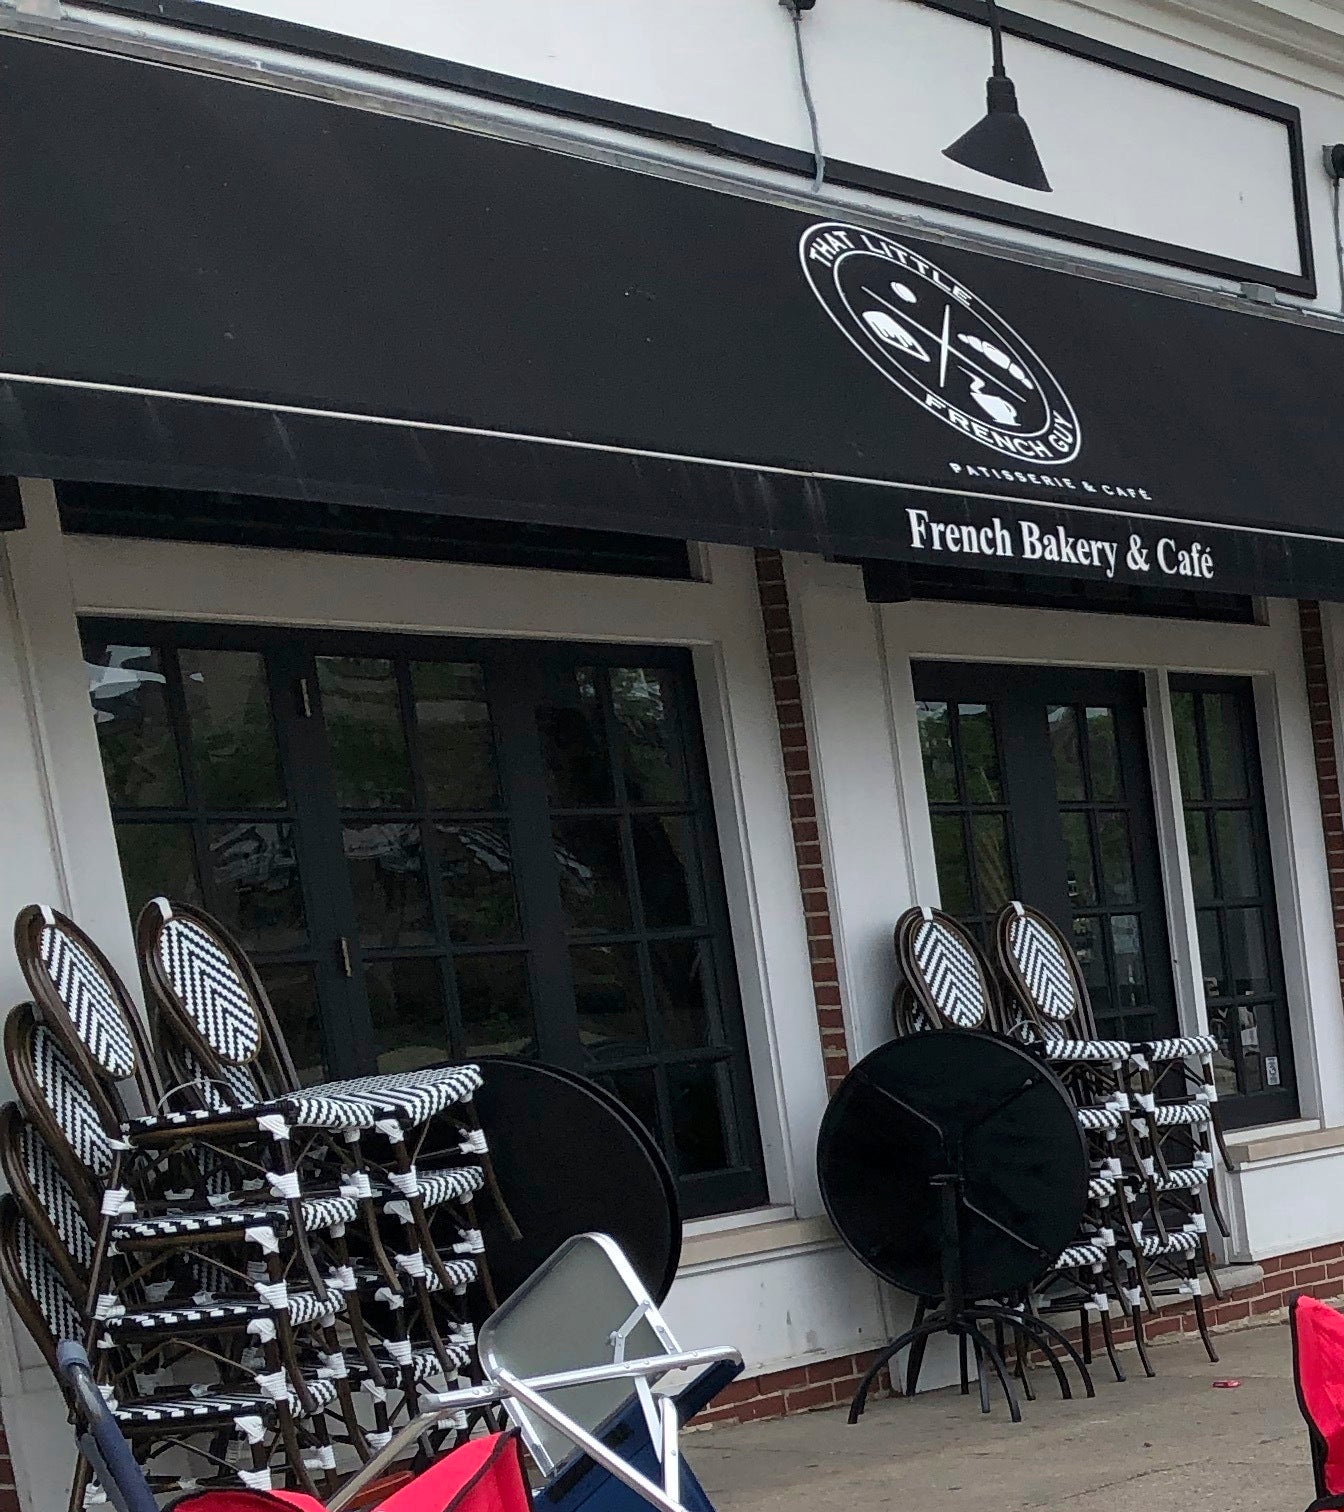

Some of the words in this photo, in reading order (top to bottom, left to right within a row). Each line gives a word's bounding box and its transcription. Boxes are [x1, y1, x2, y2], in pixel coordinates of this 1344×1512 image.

[809, 231, 855, 267] THAT
[860, 234, 972, 306] LITTLE
[924, 393, 1054, 458] FRENCH
[1048, 410, 1074, 452] GUY
[949, 462, 1076, 490] PATISSERIE
[1083, 480, 1098, 493] &
[905, 508, 1014, 558] French
[1018, 520, 1117, 579] Bakery
[1127, 533, 1150, 572] &
[1156, 538, 1215, 579] Café
